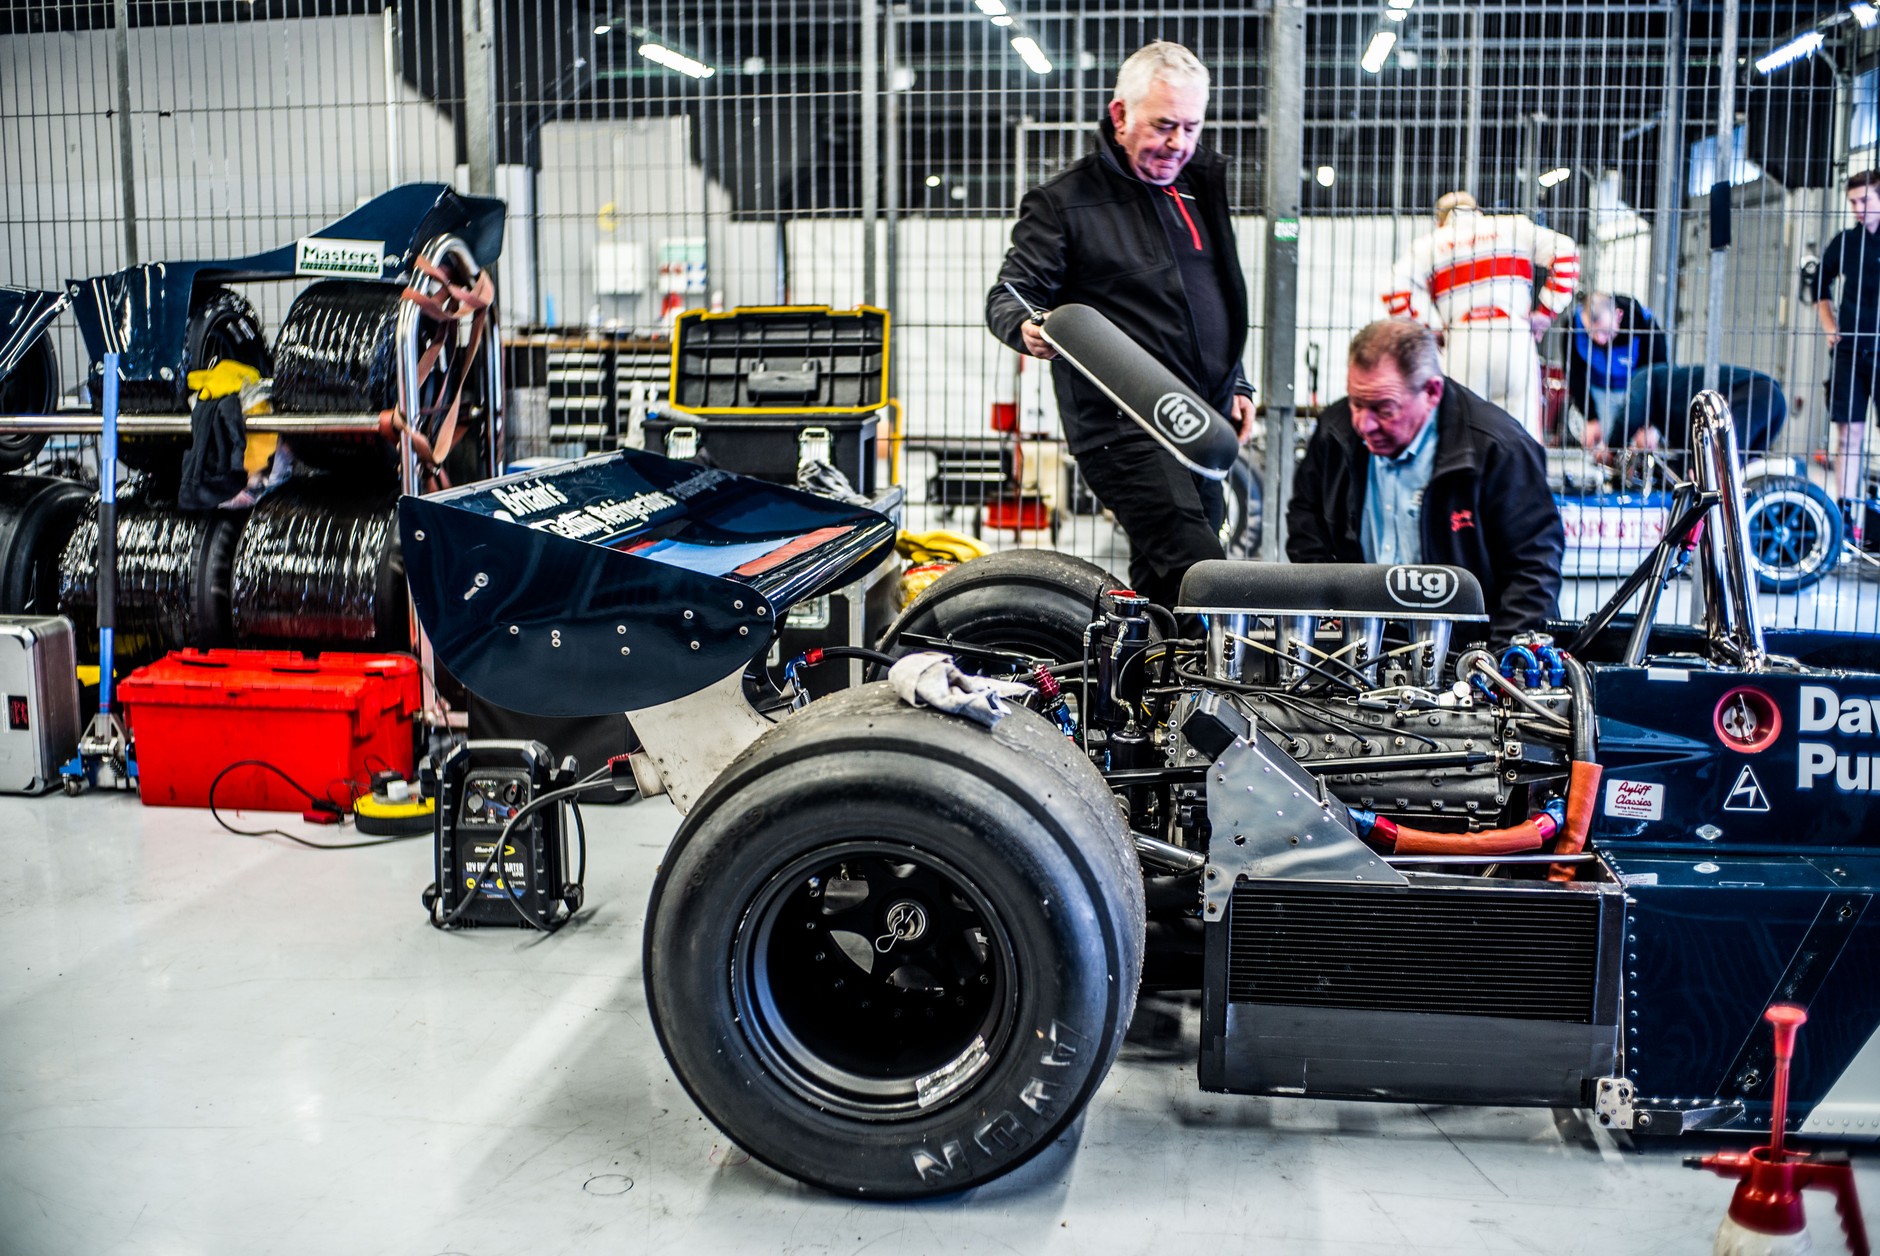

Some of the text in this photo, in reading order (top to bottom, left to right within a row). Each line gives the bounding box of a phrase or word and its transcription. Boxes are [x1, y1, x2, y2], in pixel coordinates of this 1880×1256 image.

[303, 245, 378, 264] Masters
[1161, 396, 1201, 437] itg
[1397, 568, 1447, 599] itg
[1799, 685, 1880, 733] Da
[1615, 794, 1652, 806] Classics
[1618, 781, 1652, 796] Ayliff
